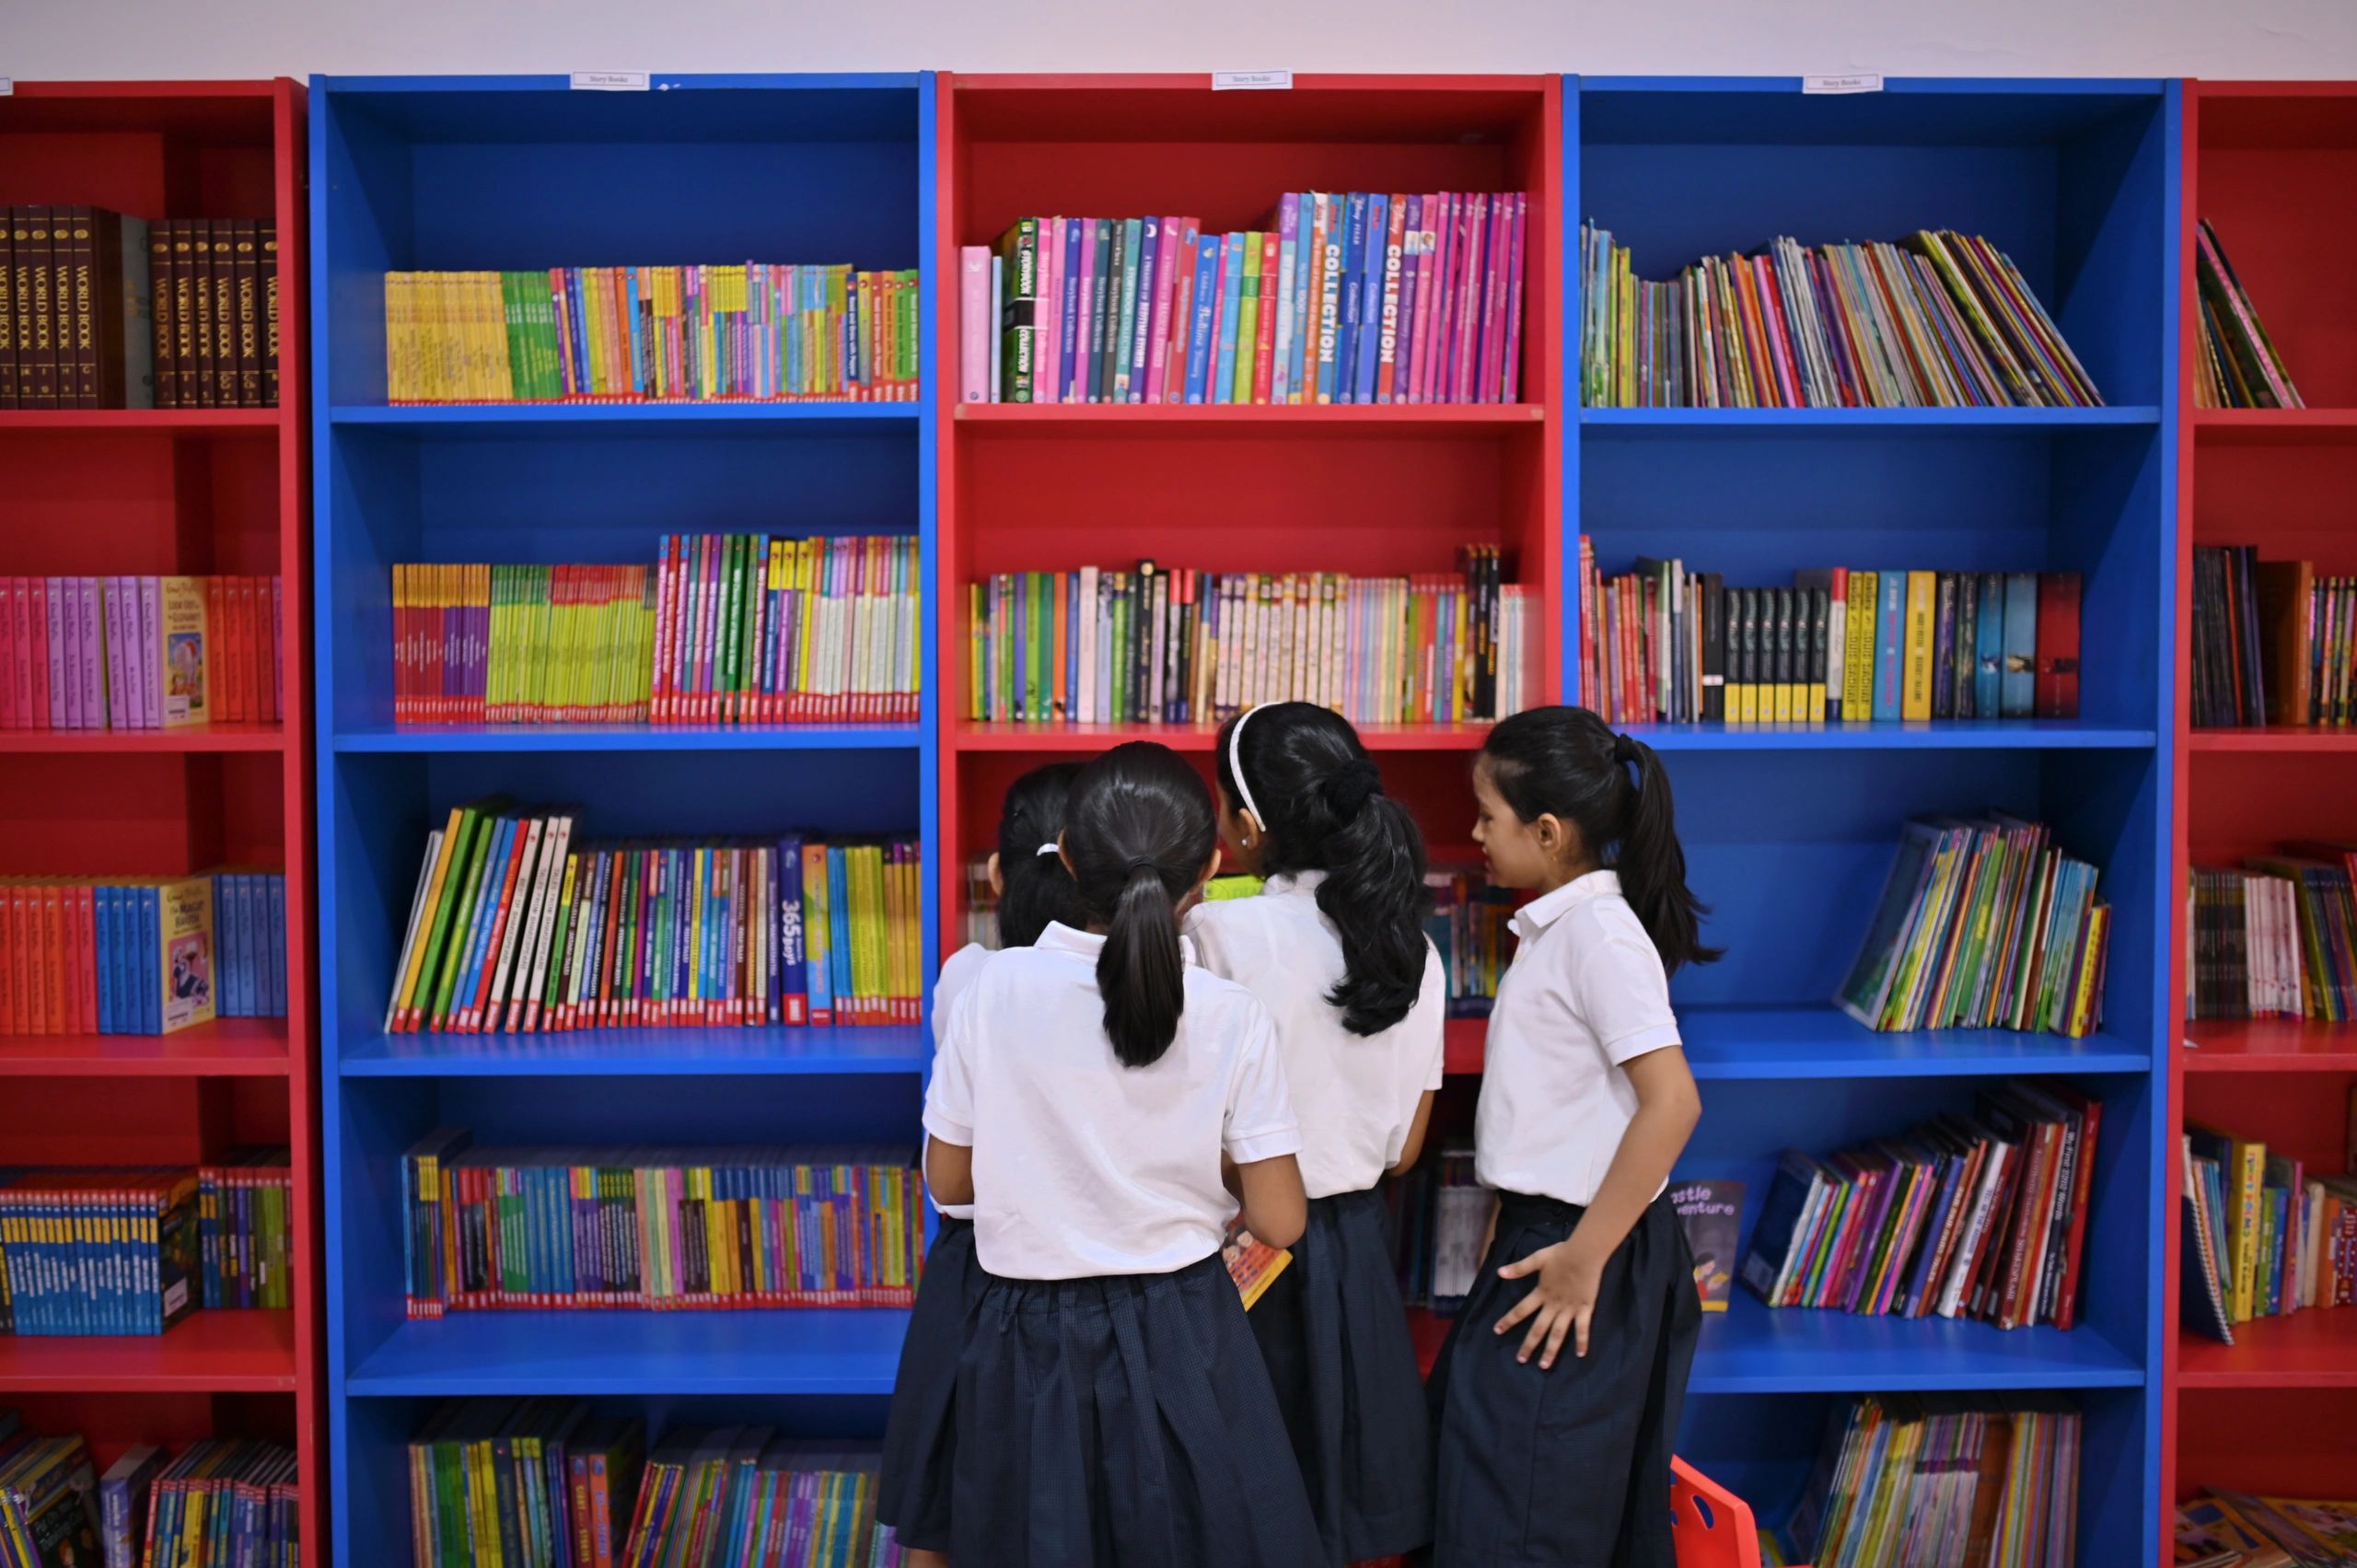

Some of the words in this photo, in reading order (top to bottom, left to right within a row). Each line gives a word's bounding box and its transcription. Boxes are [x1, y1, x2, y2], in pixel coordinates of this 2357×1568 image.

[589, 75, 606, 83] Story
[608, 75, 628, 83] Books
[1353, 223, 1362, 245] PIXAR
[17, 267, 29, 311] WORLD
[35, 267, 47, 311] WORLD
[57, 266, 69, 311] WORLD
[76, 266, 89, 311] WORLD
[1020, 250, 1031, 295] STORYBOOK
[1039, 250, 1050, 295] Storybook
[1124, 266, 1136, 315] STORYBOOK
[157, 278, 168, 322] WORLD
[179, 277, 190, 322] WORLD
[198, 277, 208, 321] WORLD
[218, 277, 229, 322] WORLD
[240, 277, 251, 322] WORLD
[1067, 277, 1075, 315] Storybook
[1081, 277, 1090, 315] Storybook
[1096, 277, 1105, 315] Storybook
[1109, 277, 1120, 314] Storybook
[1319, 244, 1341, 363] COLLECTION
[1347, 282, 1359, 323] Collection
[1366, 282, 1378, 323] Collection
[1380, 244, 1402, 363] COLLECTION
[18, 315, 30, 350] BOOK
[37, 314, 49, 350] BOOK
[58, 314, 70, 350] BOOK
[78, 314, 90, 350] BOOK
[1065, 316, 1074, 354] Collection
[1094, 316, 1103, 353] Collection
[1108, 316, 1117, 353] Collection
[1136, 302, 1150, 337] BEDTIME
[1155, 302, 1170, 337] MAGICAL
[157, 324, 169, 358] BOOK
[180, 323, 192, 357] BOOK
[200, 323, 210, 357] BOOK
[219, 324, 231, 358] BOOK
[242, 324, 254, 358] BOOK
[1017, 329, 1030, 373] COLLECTION
[1120, 316, 1132, 365] COLLECTION
[1133, 337, 1147, 368] STORIES
[536, 868, 546, 889] TALES
[551, 868, 561, 889] TALES
[514, 899, 522, 908] OF
[531, 893, 541, 914] FROM
[546, 893, 555, 914] FROM
[782, 900, 800, 936] 365
[502, 912, 519, 964] SHAKESPEARE
[521, 917, 536, 970] SHAKESPEARE
[537, 917, 551, 970] SHAKESPEARE
[782, 936, 795, 966] Boys
[1671, 1185, 1712, 1203] astle
